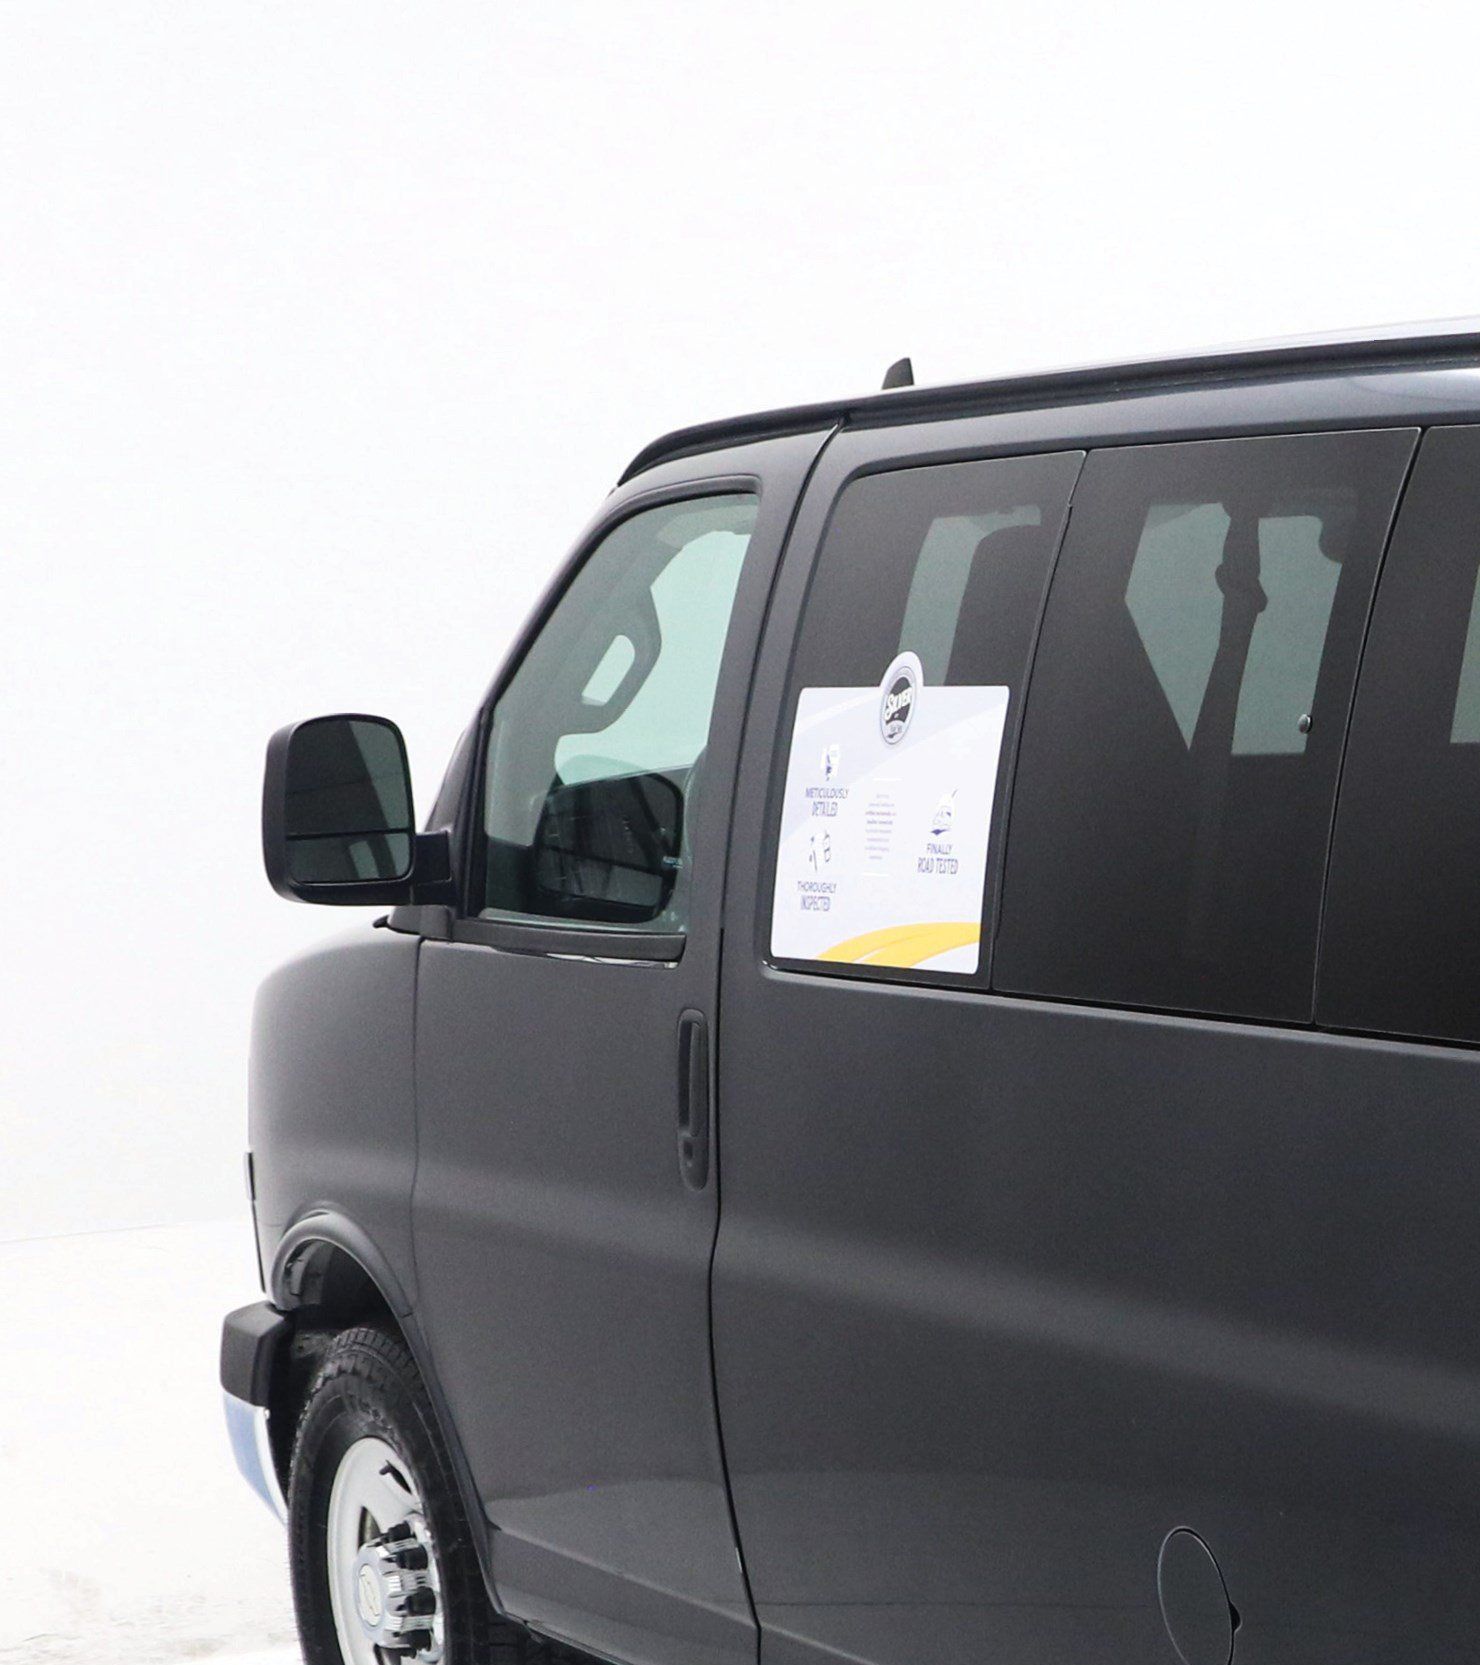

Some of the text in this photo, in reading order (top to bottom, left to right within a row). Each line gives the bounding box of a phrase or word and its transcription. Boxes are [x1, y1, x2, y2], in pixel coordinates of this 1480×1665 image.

[805, 787, 848, 799] METICULOUSLY
[927, 843, 952, 855] FINALLY
[936, 858, 959, 875] TESTED
